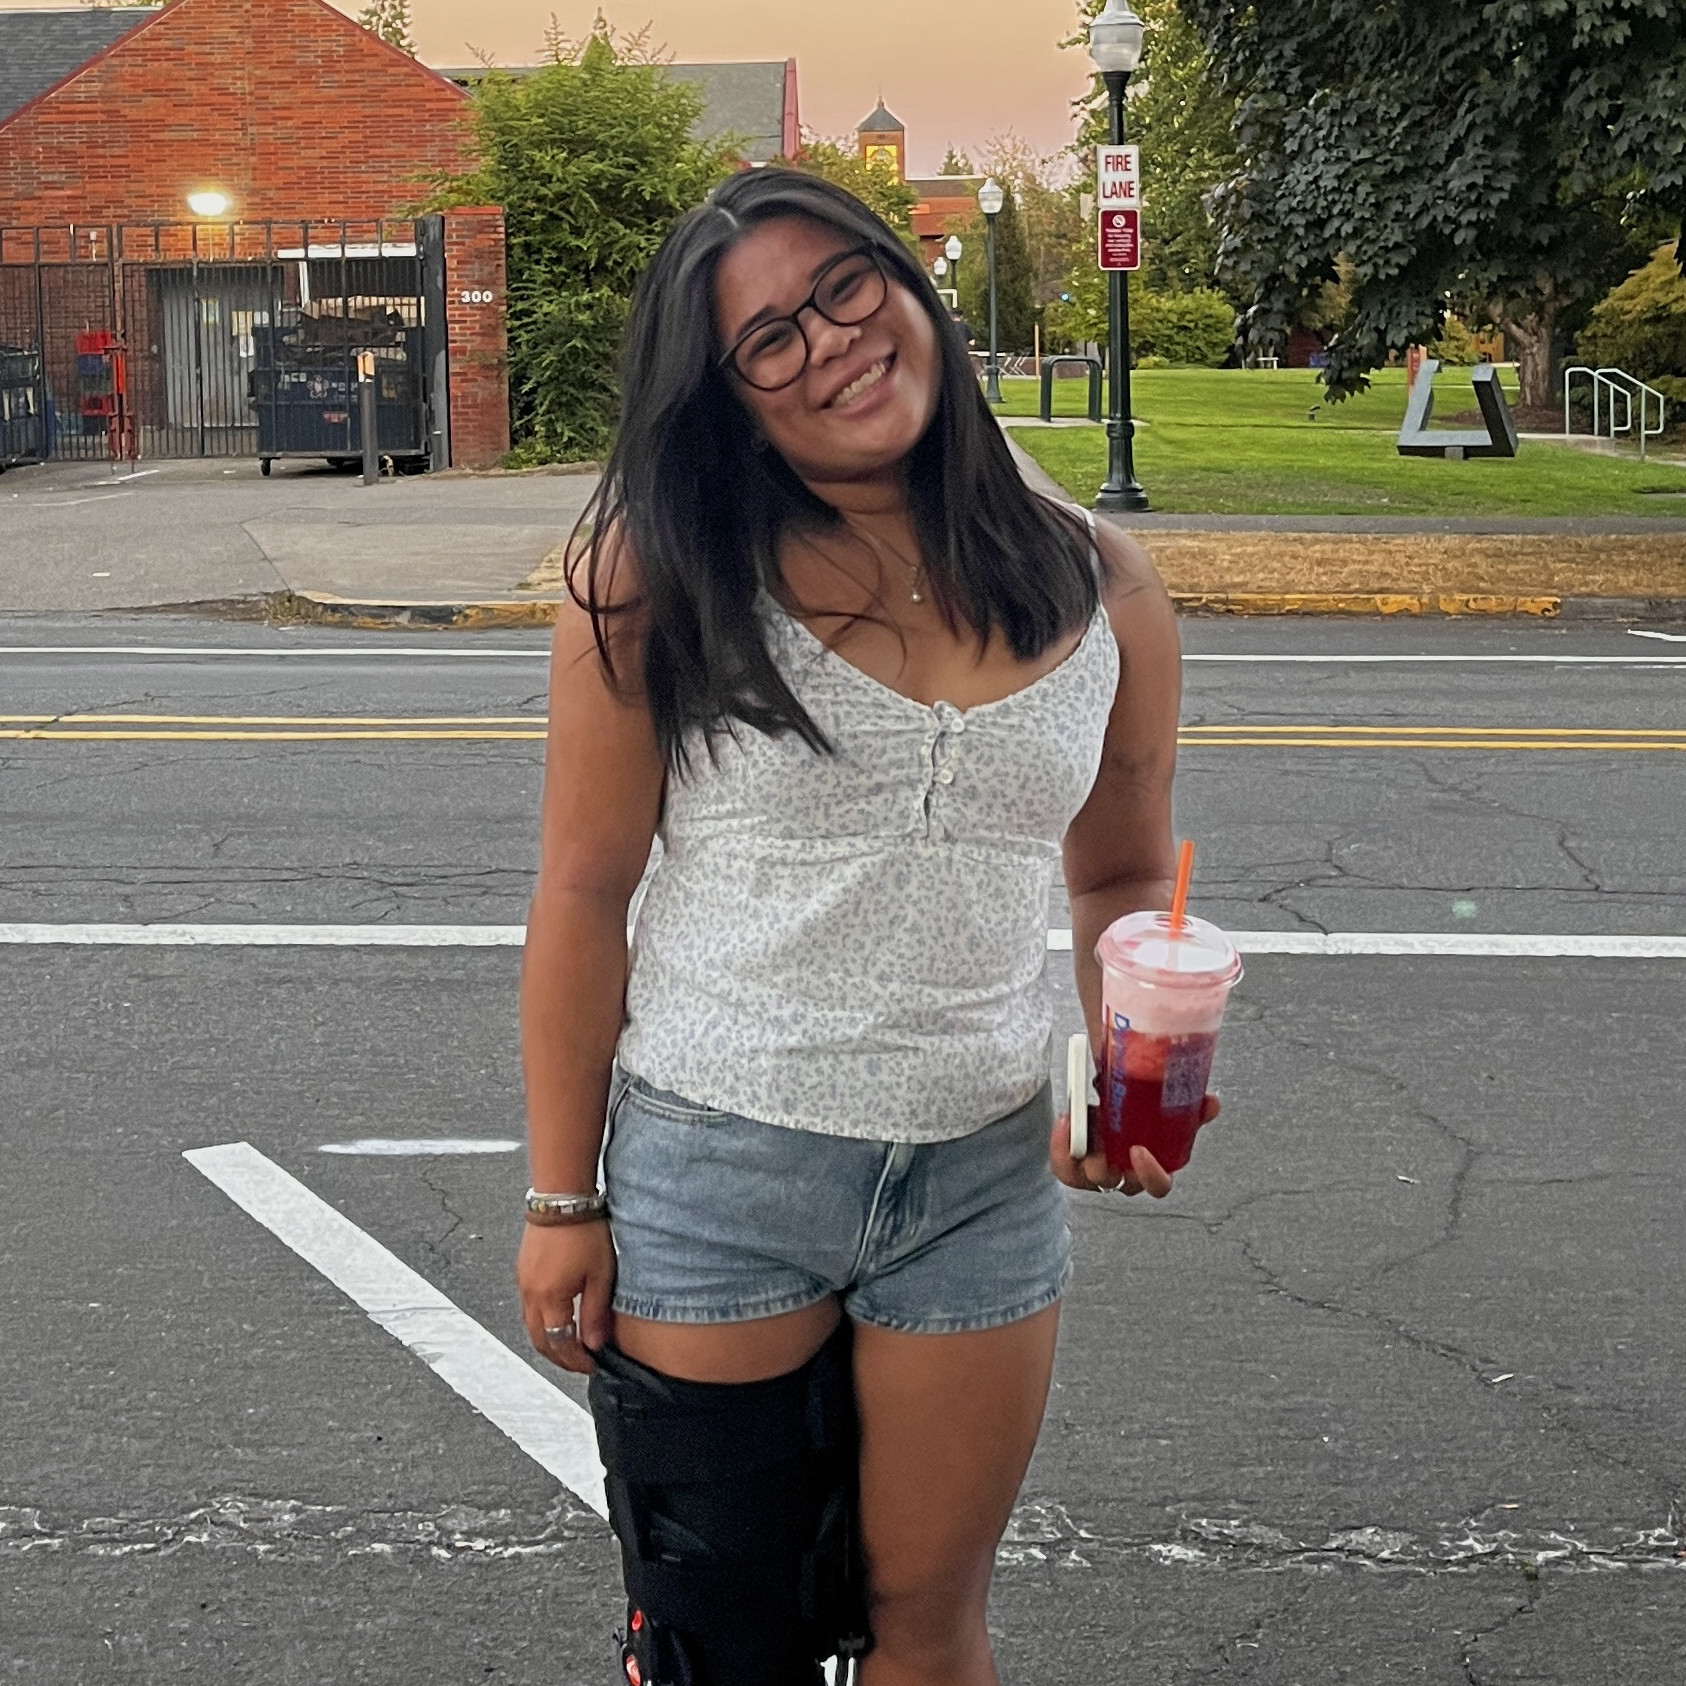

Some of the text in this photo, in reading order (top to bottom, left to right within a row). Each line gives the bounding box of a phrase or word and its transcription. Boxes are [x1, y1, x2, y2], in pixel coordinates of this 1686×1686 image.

[1105, 155, 1132, 172] FIRE
[1102, 181, 1135, 199] LANE
[461, 291, 493, 303] 300
